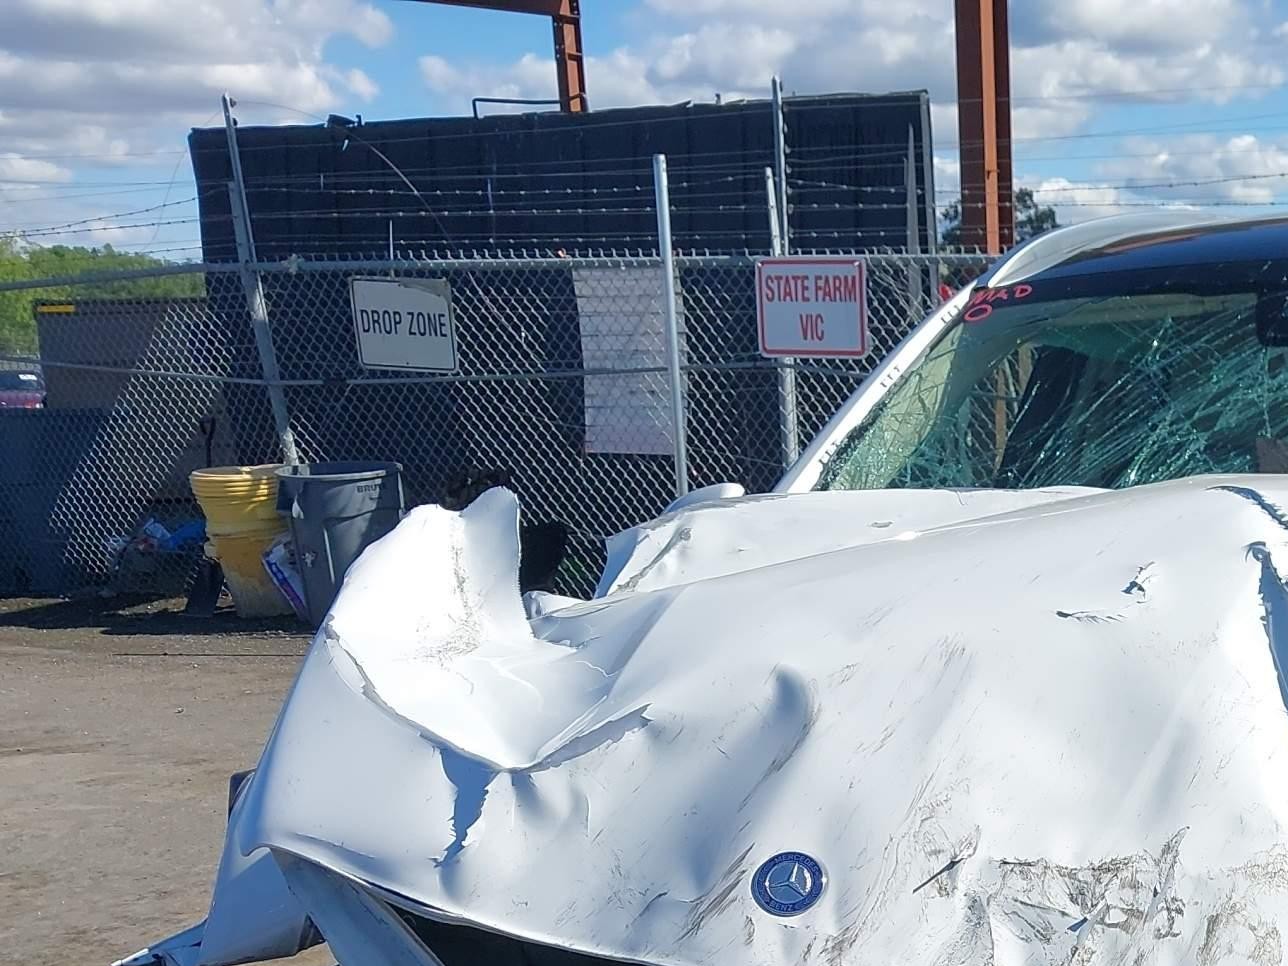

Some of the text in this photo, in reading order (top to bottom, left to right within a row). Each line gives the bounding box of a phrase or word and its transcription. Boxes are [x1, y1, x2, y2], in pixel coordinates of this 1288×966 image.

[765, 274, 857, 302] STATE FARM
[360, 309, 448, 337] DROP ZONE
[799, 313, 825, 341] VIC
[774, 854, 819, 872] MERCEDES
[769, 900, 793, 912] BENZ
